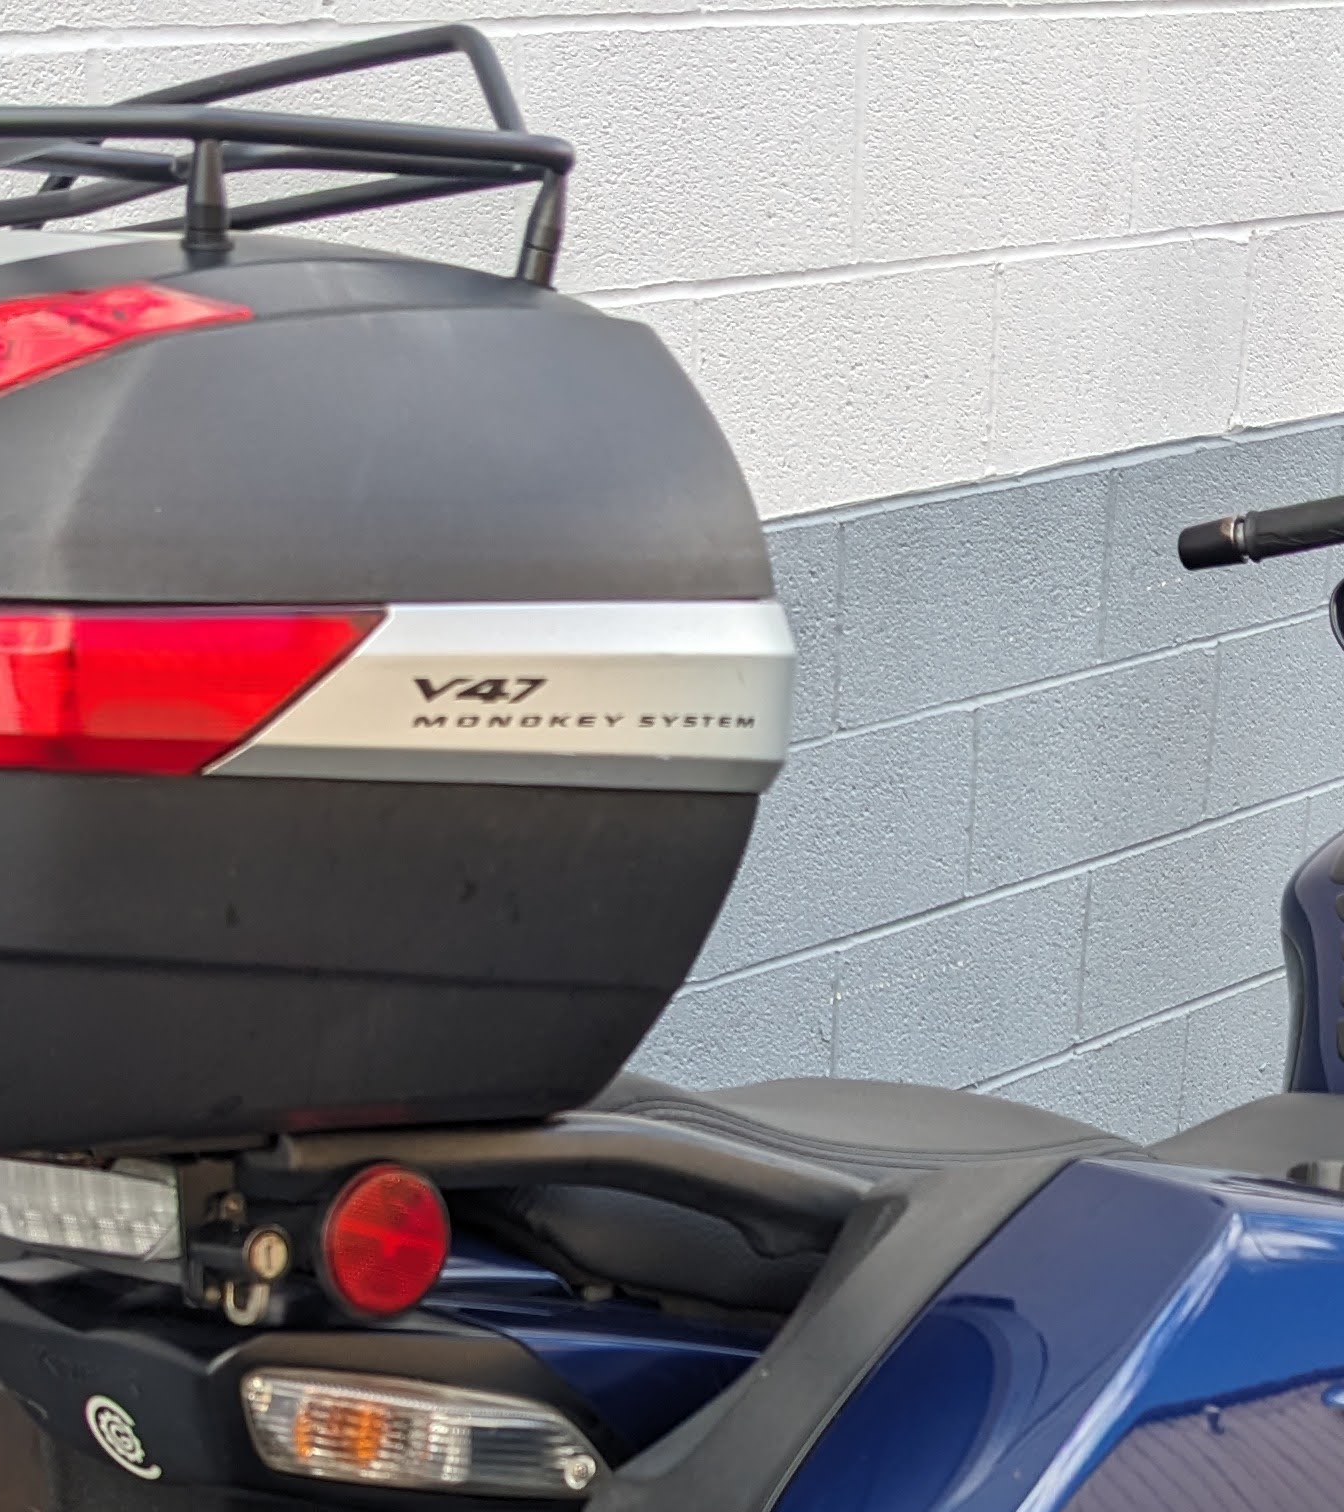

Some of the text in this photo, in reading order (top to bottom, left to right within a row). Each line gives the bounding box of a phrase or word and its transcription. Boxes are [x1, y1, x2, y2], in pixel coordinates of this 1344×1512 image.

[413, 678, 549, 704] V47
[411, 715, 756, 730] MONOKEY SYSTEM
